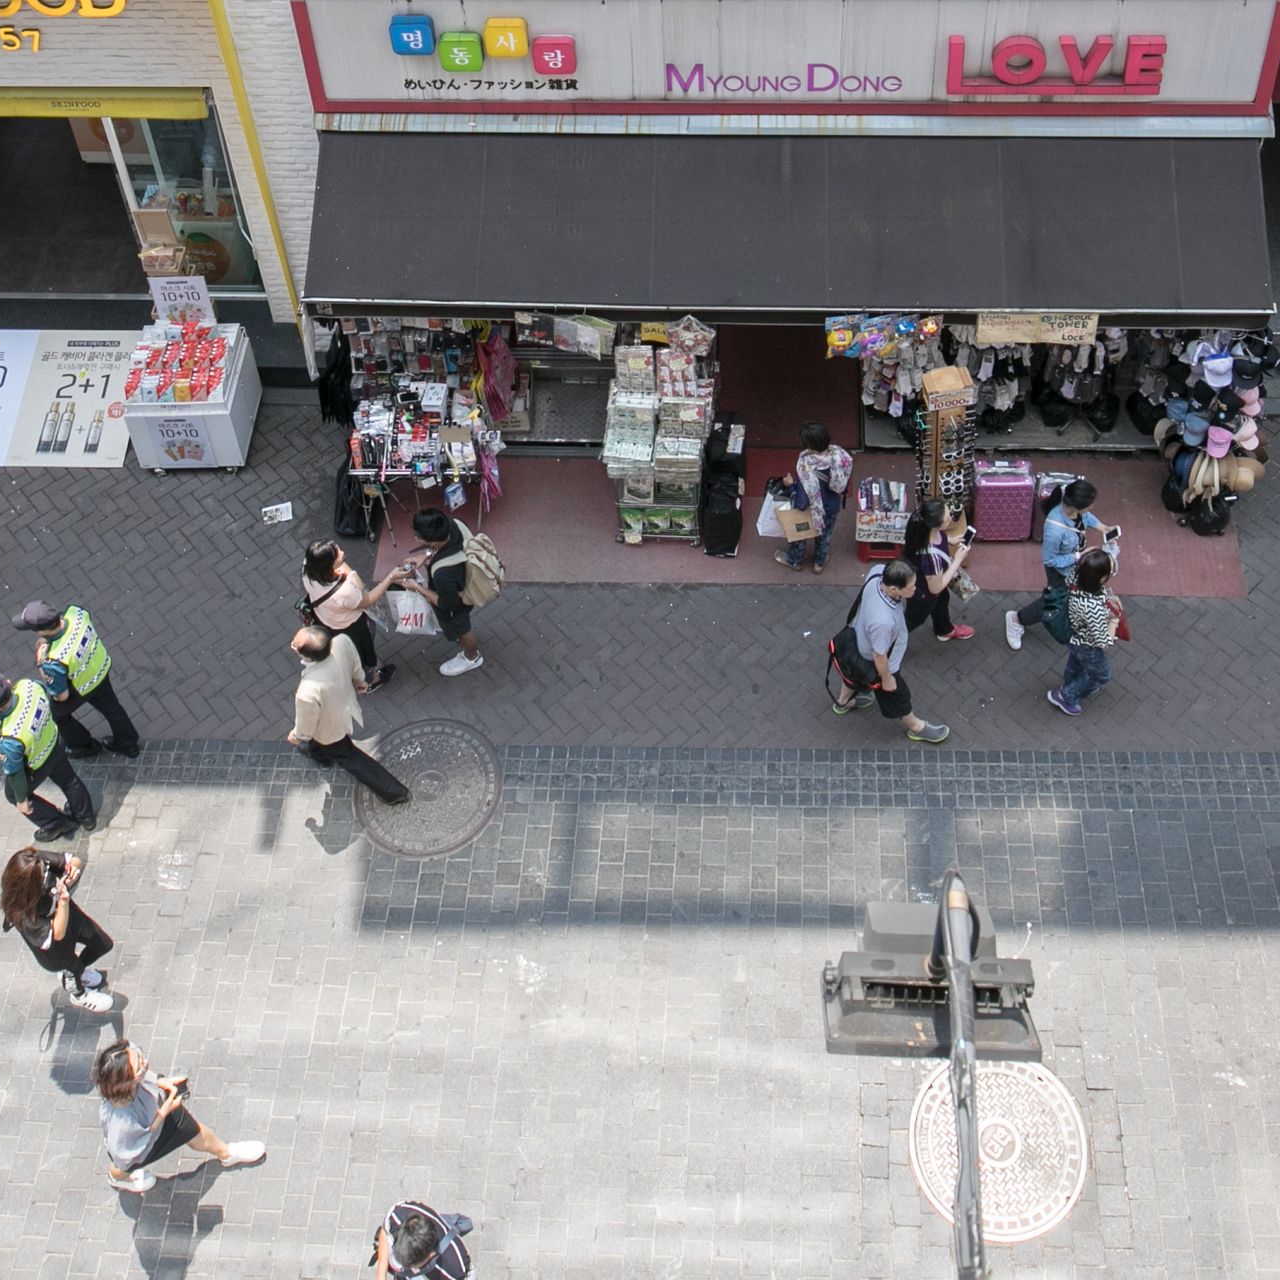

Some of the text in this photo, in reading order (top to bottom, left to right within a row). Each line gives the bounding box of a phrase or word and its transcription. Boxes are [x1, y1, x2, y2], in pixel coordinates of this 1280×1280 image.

[947, 34, 1167, 95] LOVE
[51, 100, 101, 109] SKINFOOD
[161, 291, 200, 302] 10+10
[1050, 321, 1089, 329] TOWER
[41, 351, 59, 362] 골드
[61, 351, 87, 362] 캐비어
[55, 373, 111, 399] 2+1
[158, 428, 199, 439] 10+10
